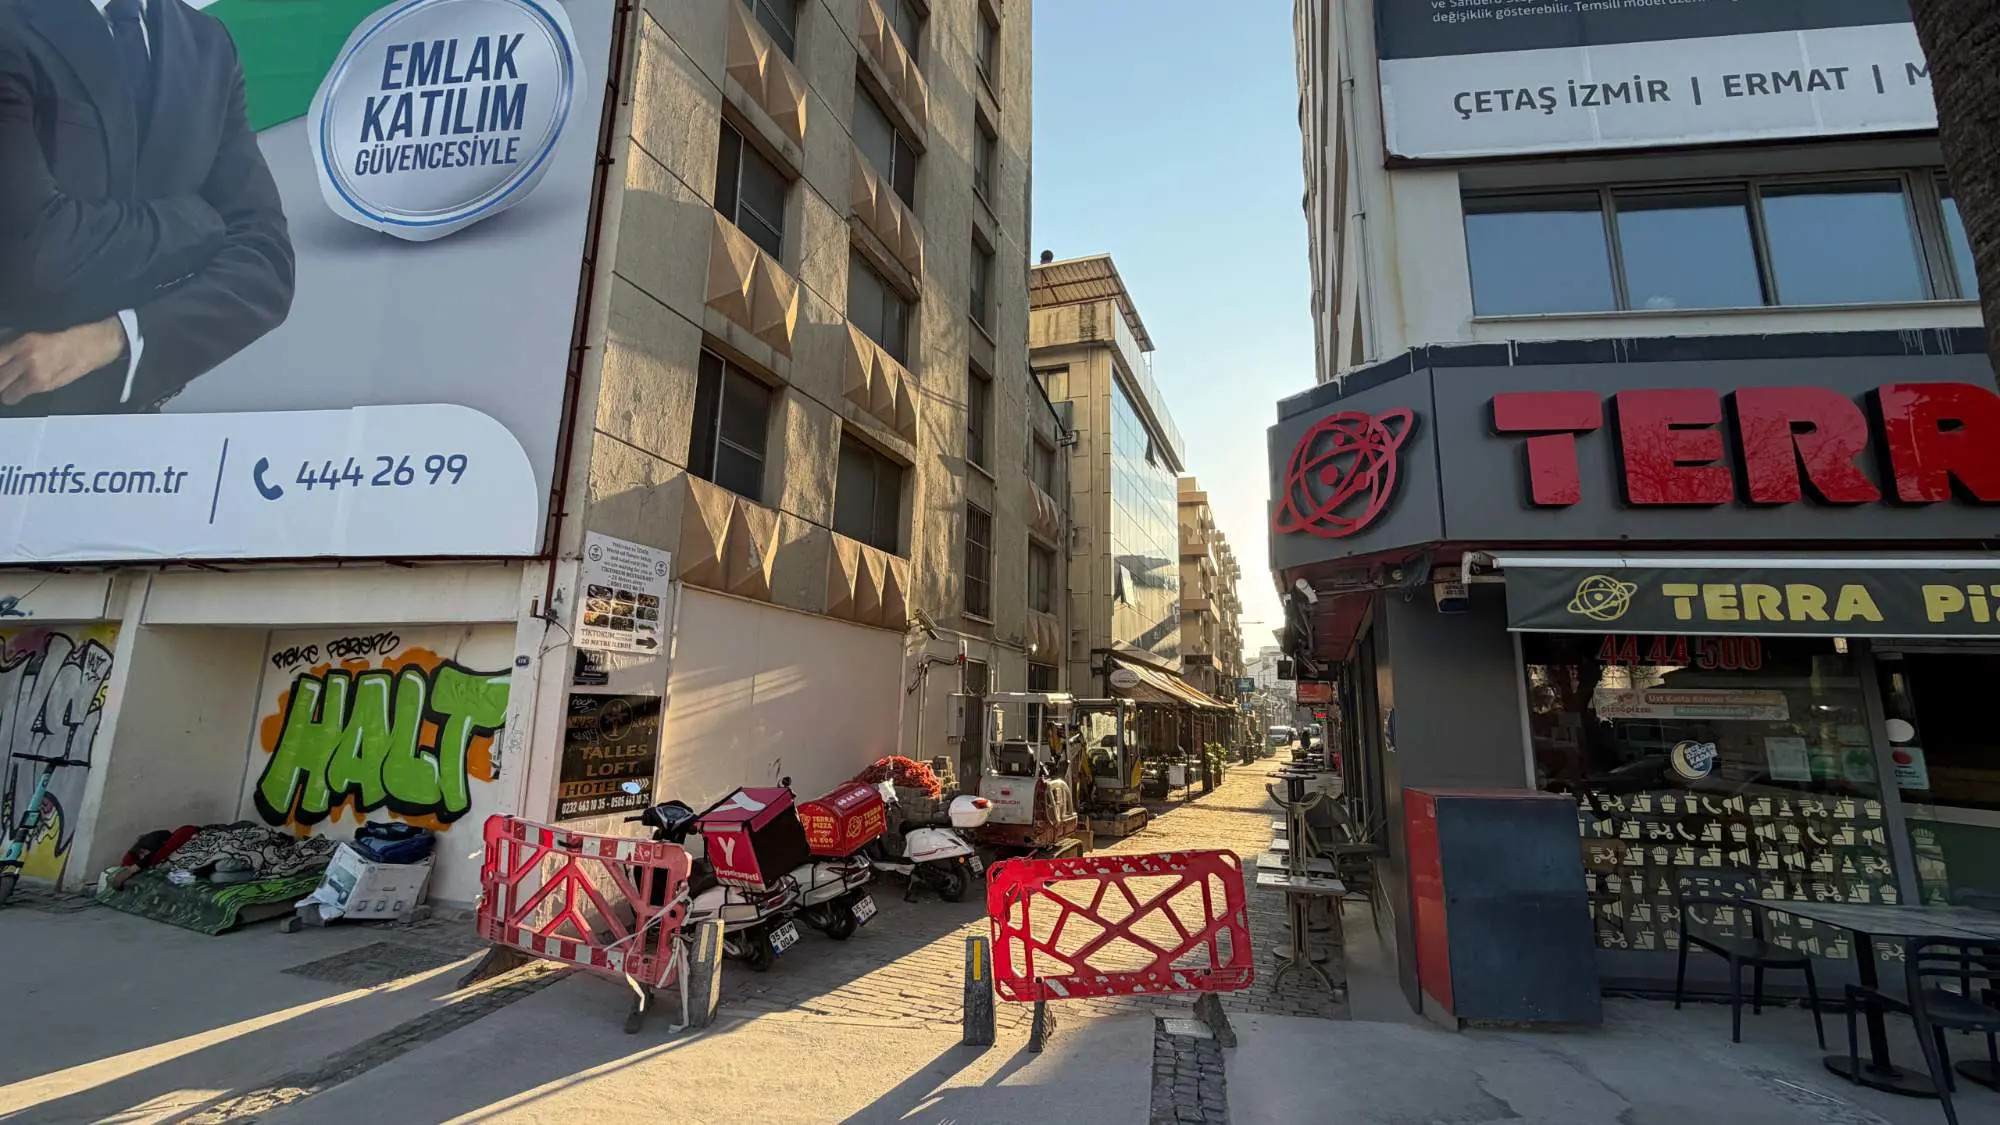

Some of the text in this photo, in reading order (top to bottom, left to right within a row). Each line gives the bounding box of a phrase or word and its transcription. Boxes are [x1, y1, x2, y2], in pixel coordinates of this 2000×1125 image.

[1431, 0, 1446, 9] ve
[1432, 9, 1493, 23] değişiklik
[1495, 3, 1572, 20] gösterebilir.
[1576, 0, 1621, 12] Temsili
[381, 33, 526, 91] EMLAK
[1453, 86, 1557, 120] ÇETAŞ
[1567, 74, 1672, 108] İZMİR
[1722, 66, 1849, 98] ERMAT
[360, 83, 528, 143] KATILIM
[354, 135, 521, 176] GÜVENCESİYLE
[295, 454, 468, 491] 444 26 99
[1661, 583, 2000, 623] TERRA Pi
[1597, 634, 1762, 671] 44 44 500
[254, 659, 512, 827] HALT
[580, 744, 648, 760] TALLES
[586, 761, 640, 777] LOFT
[561, 802, 577, 815] 0232
[852, 905, 862, 915] 35
[770, 923, 795, 943] 35 BUM
[780, 933, 794, 948] 004
